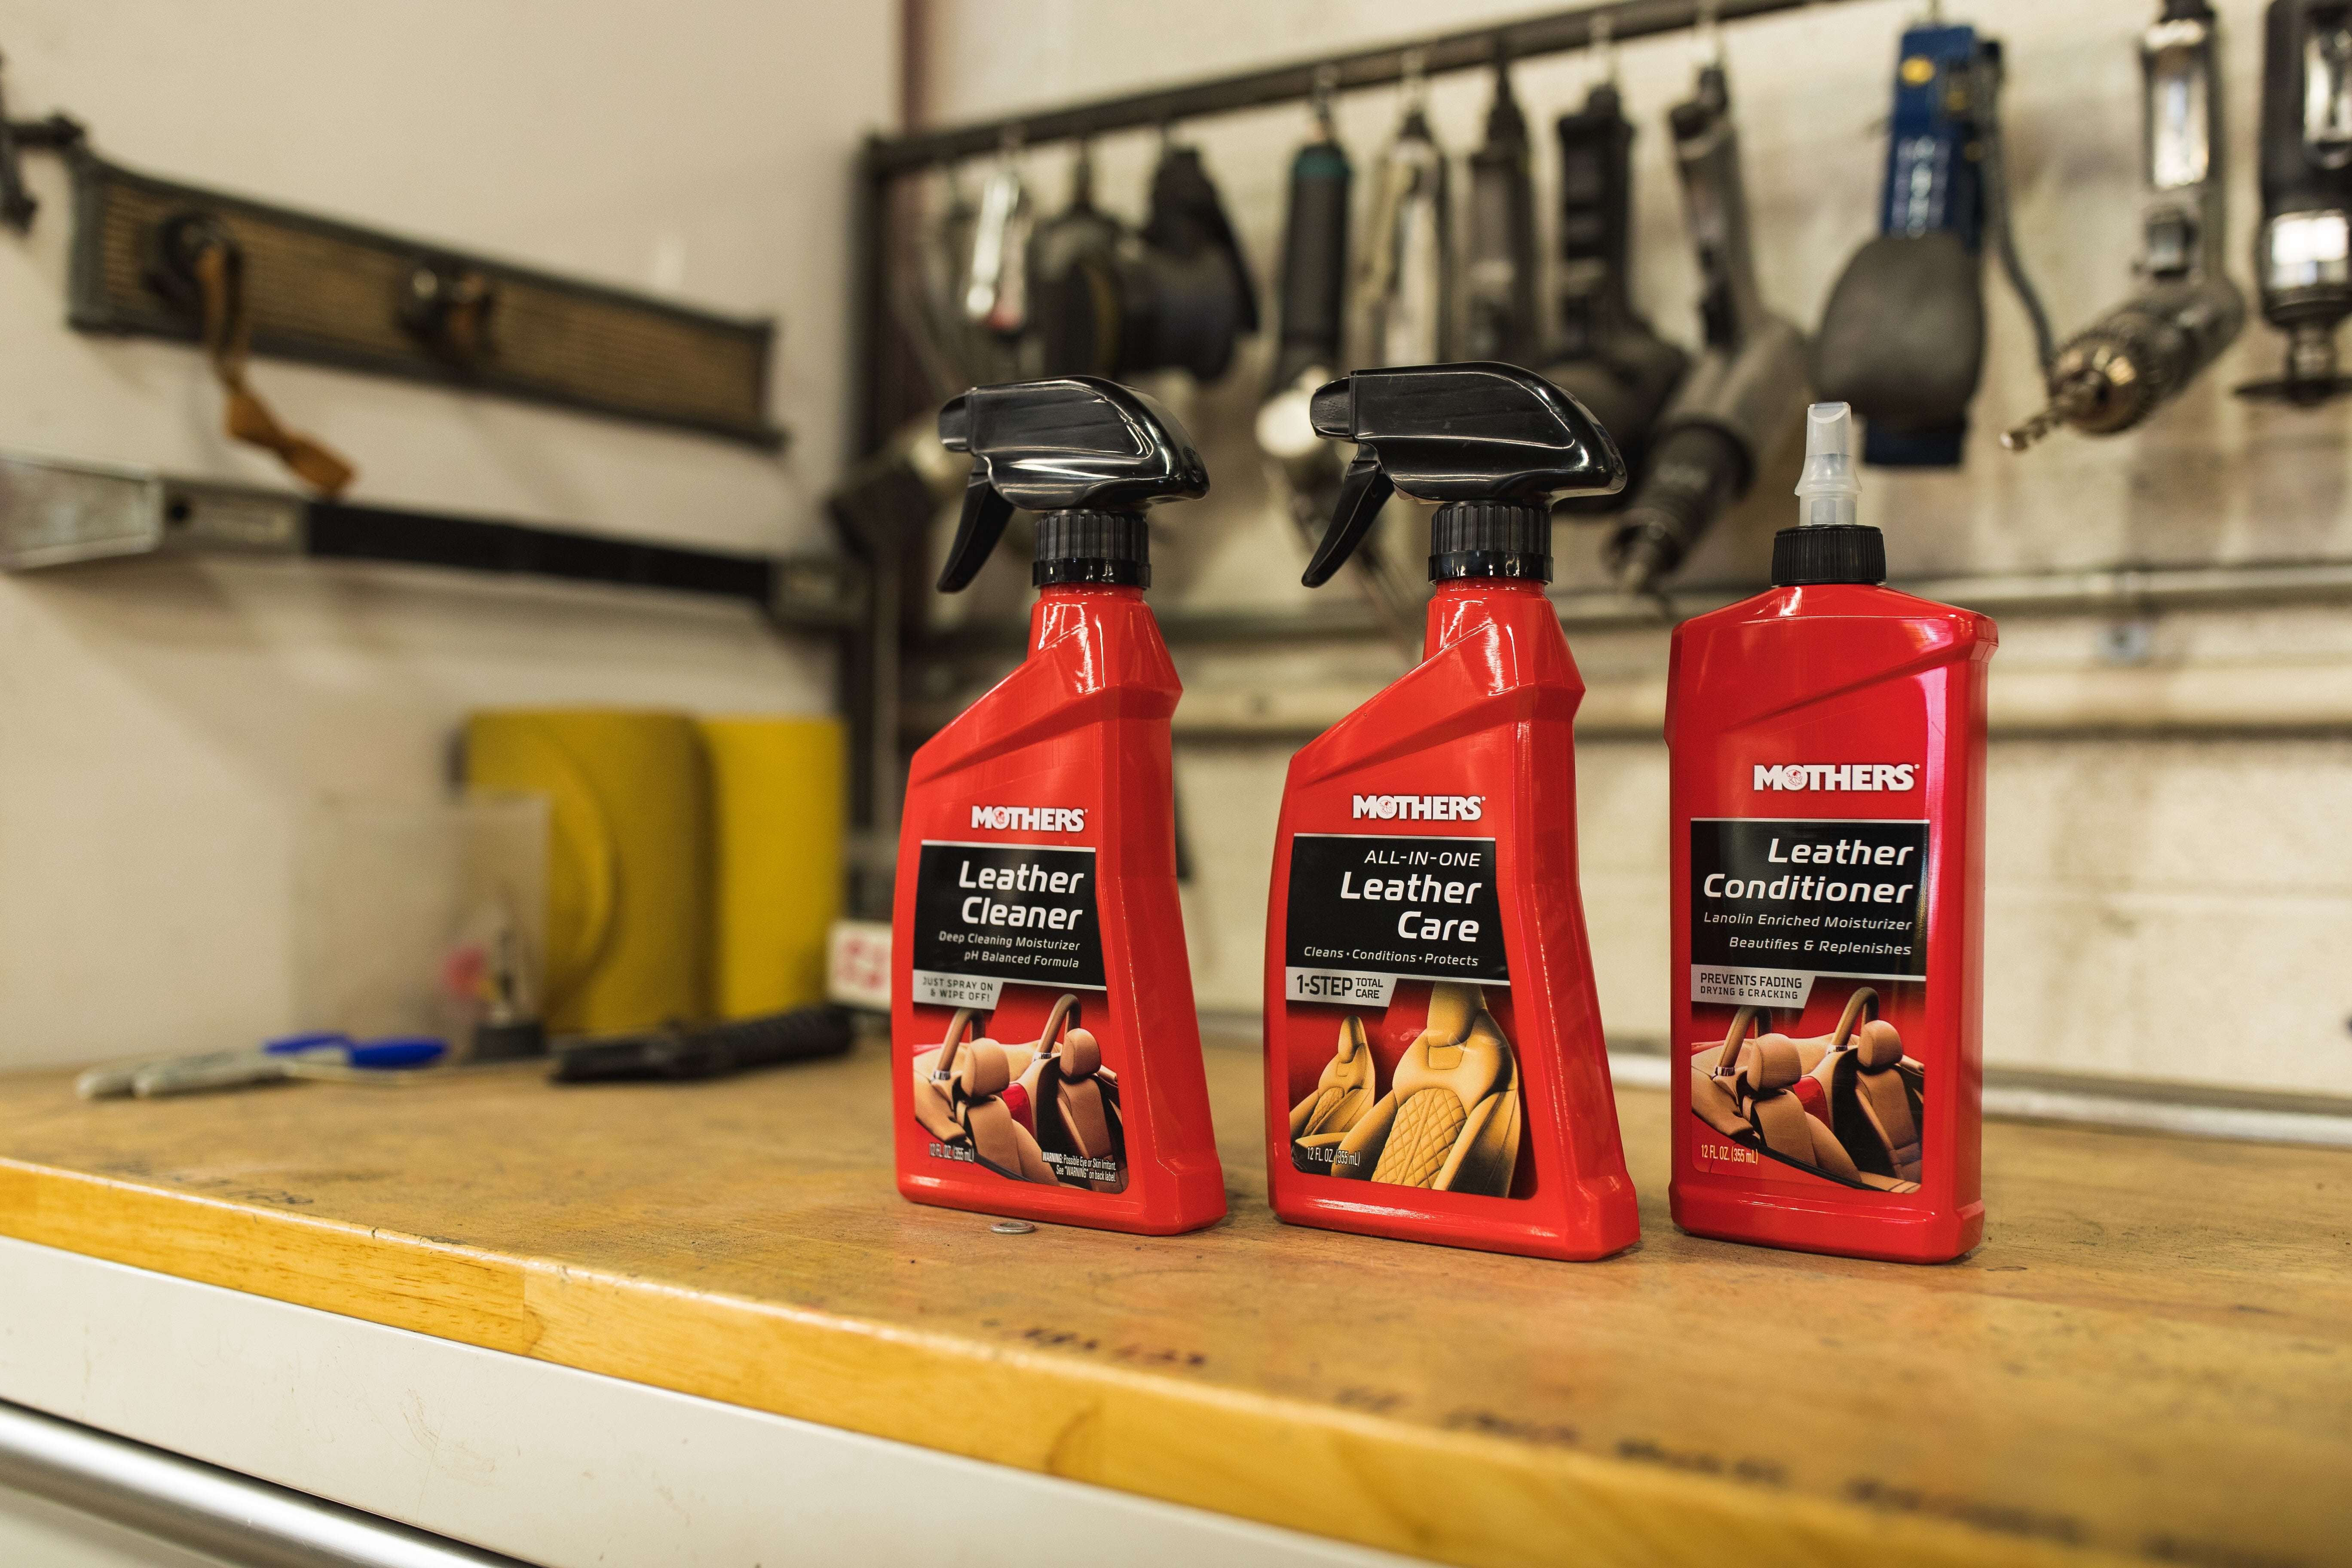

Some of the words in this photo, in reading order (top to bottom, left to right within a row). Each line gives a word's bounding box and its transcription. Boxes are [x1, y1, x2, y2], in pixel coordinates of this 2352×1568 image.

[1754, 764, 1914, 791] MOTHERS
[1353, 795, 1482, 821] MOTHERS
[971, 805, 1084, 832] MOTHERS
[1365, 850, 1481, 867] ALL-IN-ONE
[1768, 838, 1914, 866] Leather
[959, 861, 1084, 894] Leather
[1340, 871, 1482, 904] Leather
[1704, 873, 1914, 903] Conditioner
[962, 897, 1082, 930] Cleaner
[1704, 912, 1753, 925] Lanolin
[1758, 914, 1820, 927] Enriched
[1825, 916, 1912, 931] Moisturizer
[1398, 911, 1479, 942] Care
[939, 931, 965, 944] Deep
[968, 933, 1012, 948] Cleaning
[1016, 937, 1080, 951] Moisturizer
[1729, 937, 1799, 951] Beautifies
[1804, 940, 1814, 951] &
[1819, 940, 1912, 955] Replenishes
[964, 950, 978, 962] pH
[982, 952, 1030, 965] Balanced
[1034, 956, 1079, 968] Formula
[1305, 946, 1344, 959] Cleans
[1352, 949, 1416, 963] Conditions
[1425, 953, 1479, 966] Protects
[923, 977, 944, 986] JUST
[947, 979, 977, 989] SPRAY
[980, 983, 993, 991] ON
[1296, 974, 1354, 997] 1-STEP
[1356, 977, 1384, 988] TOTAL
[1700, 973, 1756, 986] PREVENTS
[1760, 976, 1802, 989] FADING
[931, 988, 935, 996] &
[940, 990, 964, 999] WIPE
[969, 992, 989, 1001] OFF!
[1356, 988, 1379, 999] CARE
[1700, 986, 1735, 995] DRYING
[1748, 989, 1798, 999] CRACKING
[1042, 1152, 1063, 1164] WARNING:
[1064, 1155, 1079, 1165] Possible
[1093, 1158, 1101, 1168] Skin
[1102, 1159, 1116, 1170] Irritant.
[1308, 1147, 1314, 1160] 12
[1325, 1148, 1334, 1162] OZ.
[1335, 1148, 1348, 1164] (355
[1349, 1151, 1360, 1167] mL)
[1701, 1144, 1708, 1158] 12
[1710, 1145, 1718, 1159] FL.
[1719, 1146, 1730, 1161] OZ.
[1731, 1146, 1745, 1162] (355
[1746, 1148, 1758, 1165] mL)
[1095, 1170, 1104, 1180] back
[1105, 1171, 1116, 1182] label.
